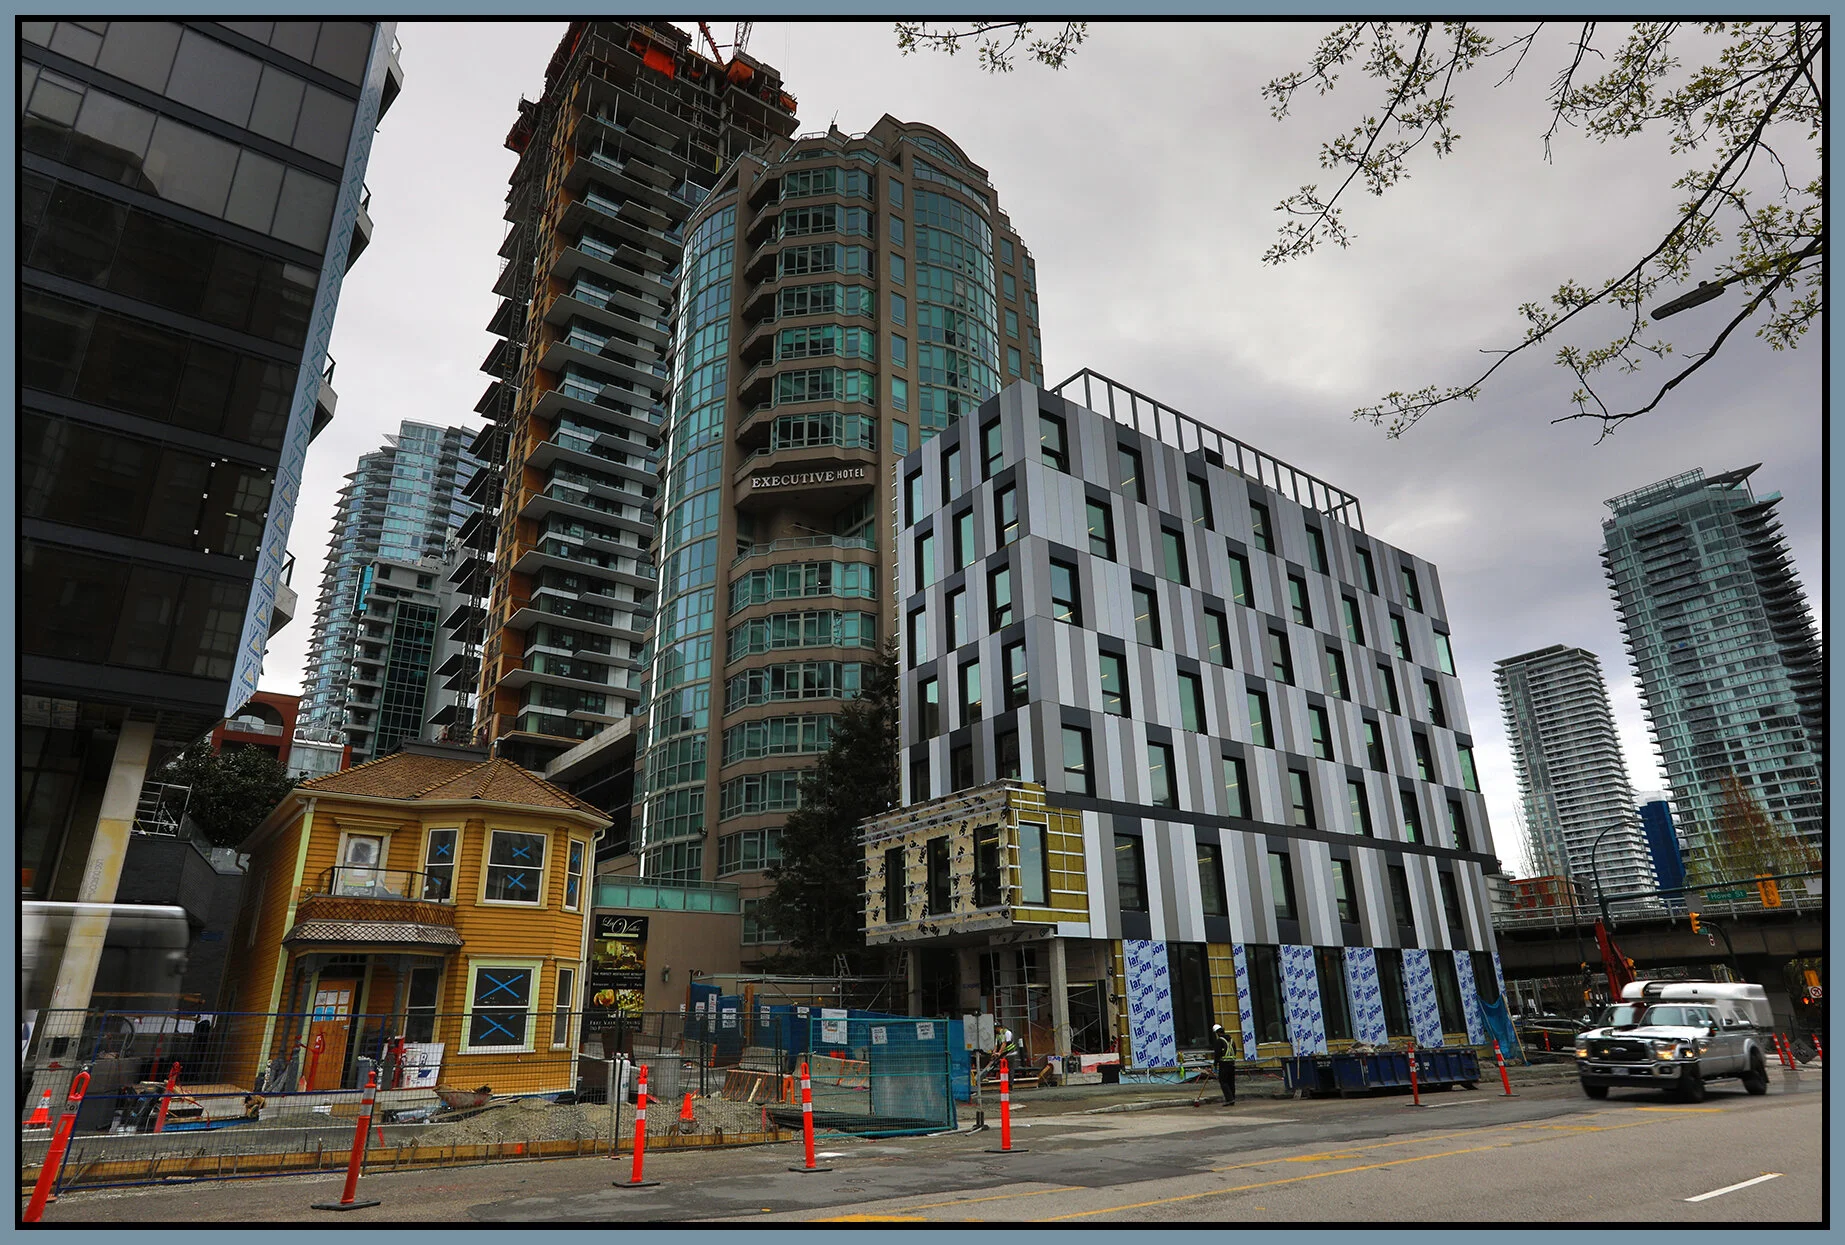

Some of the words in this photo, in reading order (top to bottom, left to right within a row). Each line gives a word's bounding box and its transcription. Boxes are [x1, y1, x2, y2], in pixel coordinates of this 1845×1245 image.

[752, 470, 835, 488] EXECUTIVE
[836, 468, 865, 480] HOTEL
[1128, 955, 1139, 966] lar
[1130, 978, 1141, 990] lar
[1132, 1002, 1143, 1014] lar
[1134, 1025, 1145, 1038] lar
[1136, 1049, 1147, 1062] lar
